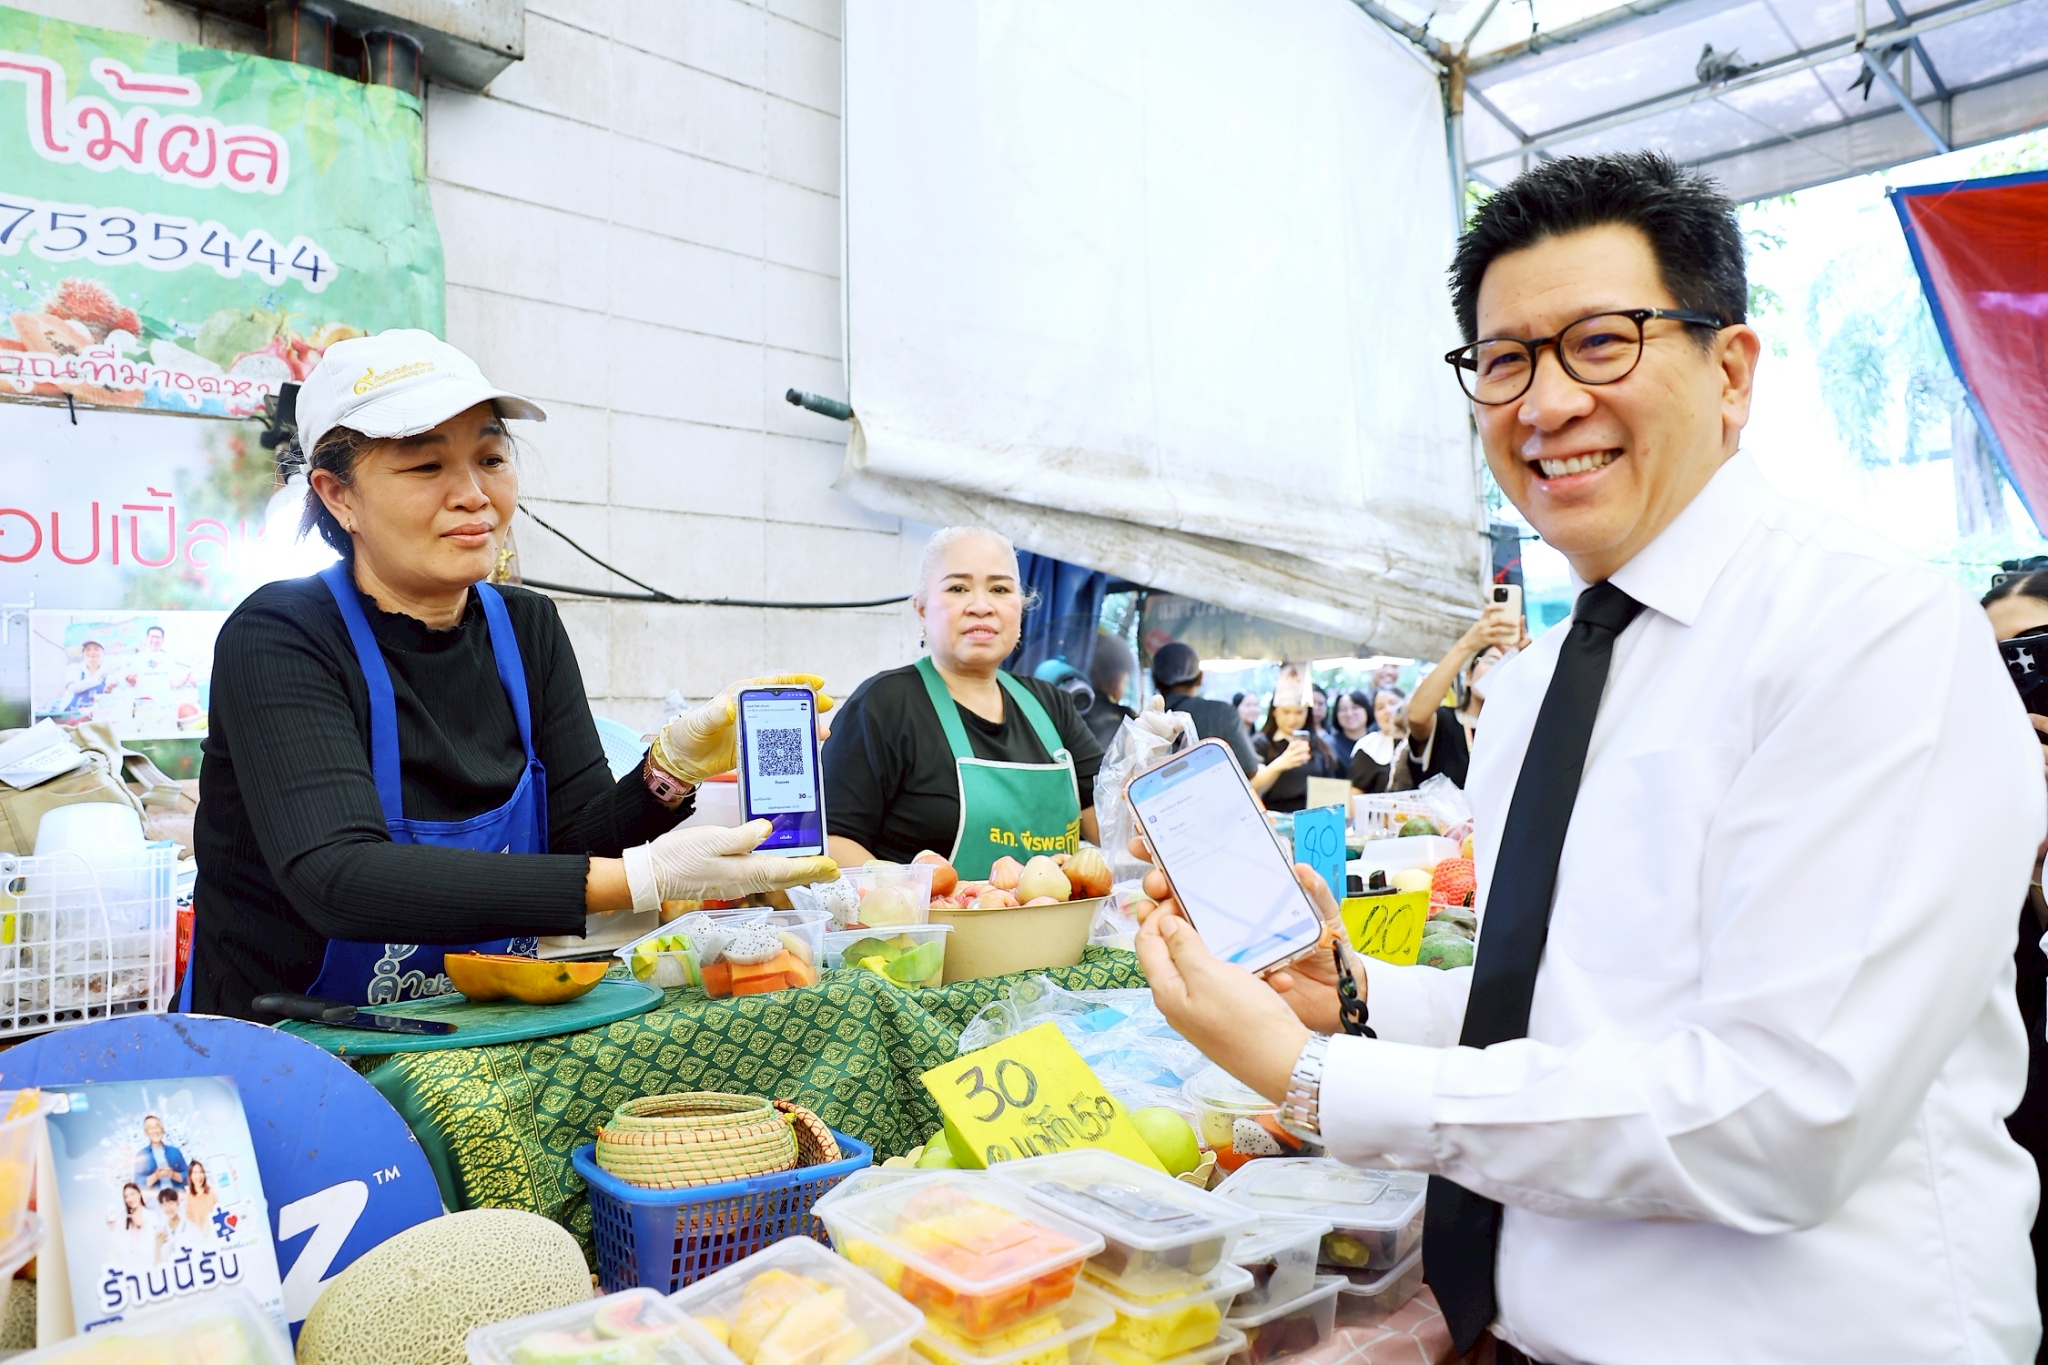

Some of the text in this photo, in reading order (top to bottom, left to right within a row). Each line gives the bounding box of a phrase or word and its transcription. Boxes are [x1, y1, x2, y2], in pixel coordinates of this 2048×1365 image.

[0, 203, 328, 283] 7535444
[989, 827, 1019, 848] ส.ก.
[1304, 825, 1338, 870] 80
[955, 1058, 1039, 1123] 30
[372, 1164, 401, 1186] TM
[104, 1246, 239, 1307] ร้านนี้รับ
